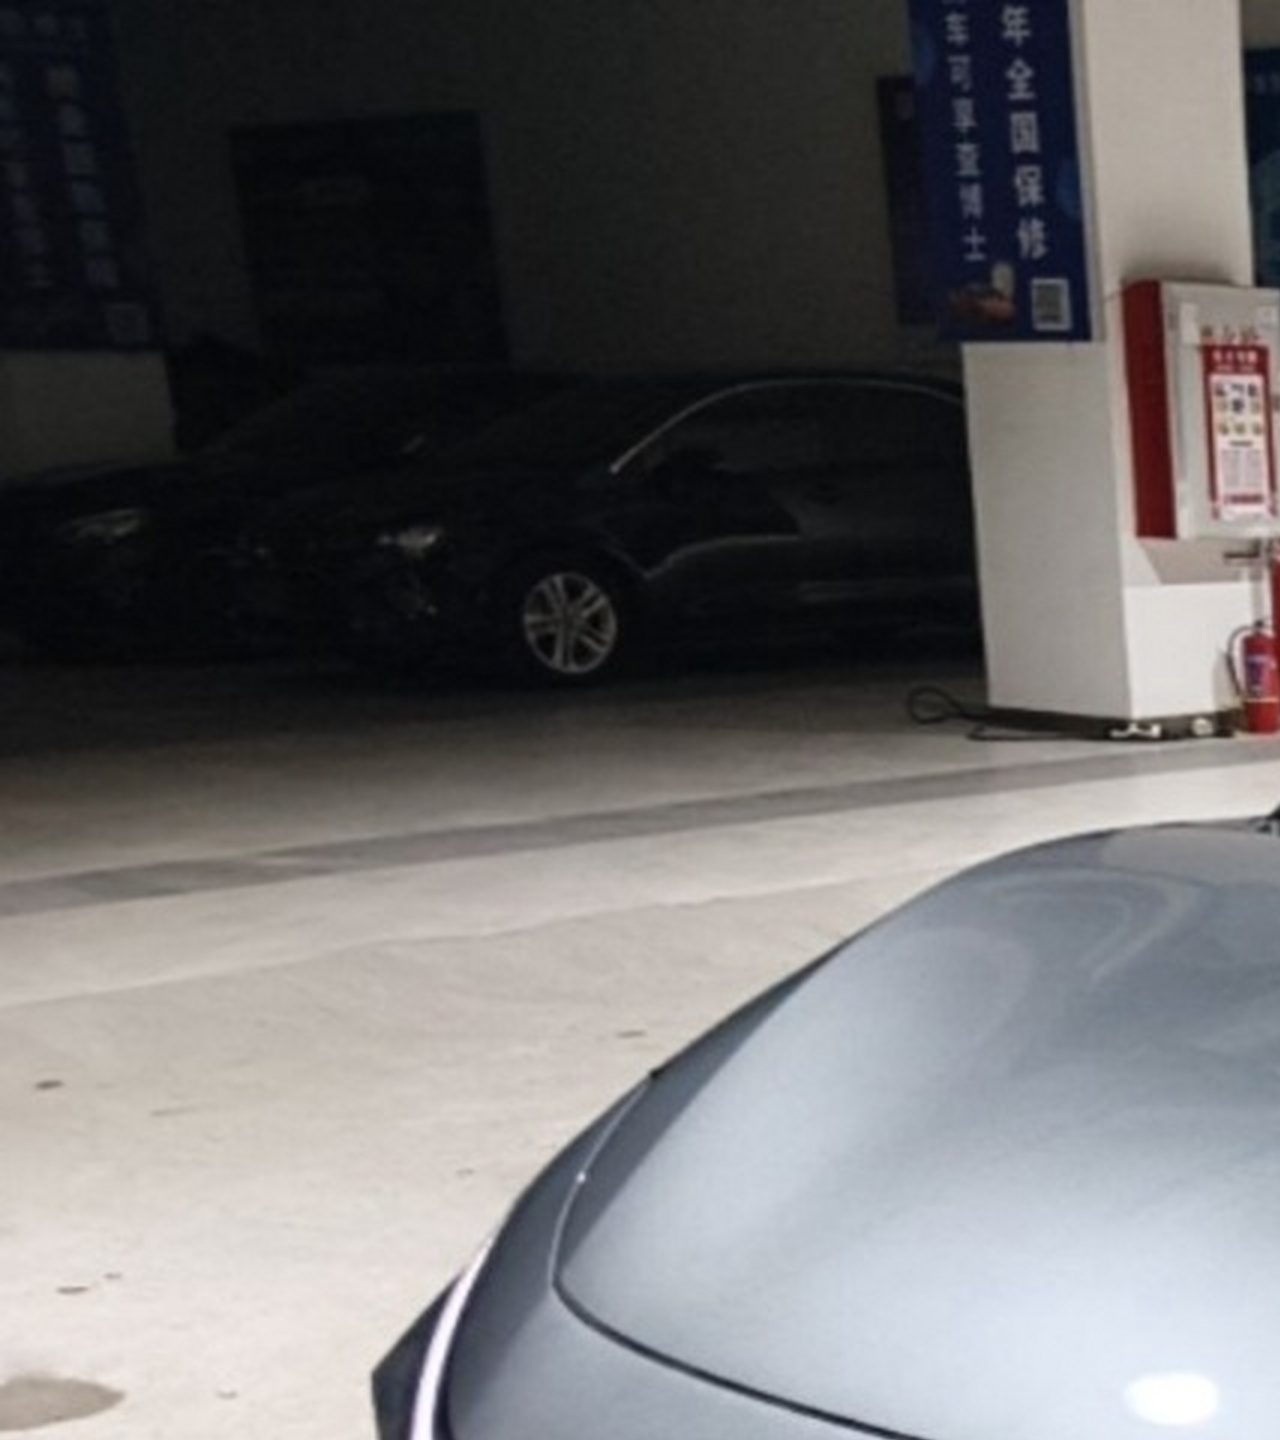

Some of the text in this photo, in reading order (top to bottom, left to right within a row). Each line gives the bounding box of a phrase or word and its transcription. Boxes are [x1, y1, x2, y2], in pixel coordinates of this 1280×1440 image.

[943, 0, 987, 261] 车可享查博士
[999, 4, 1048, 260] 年全国保修
